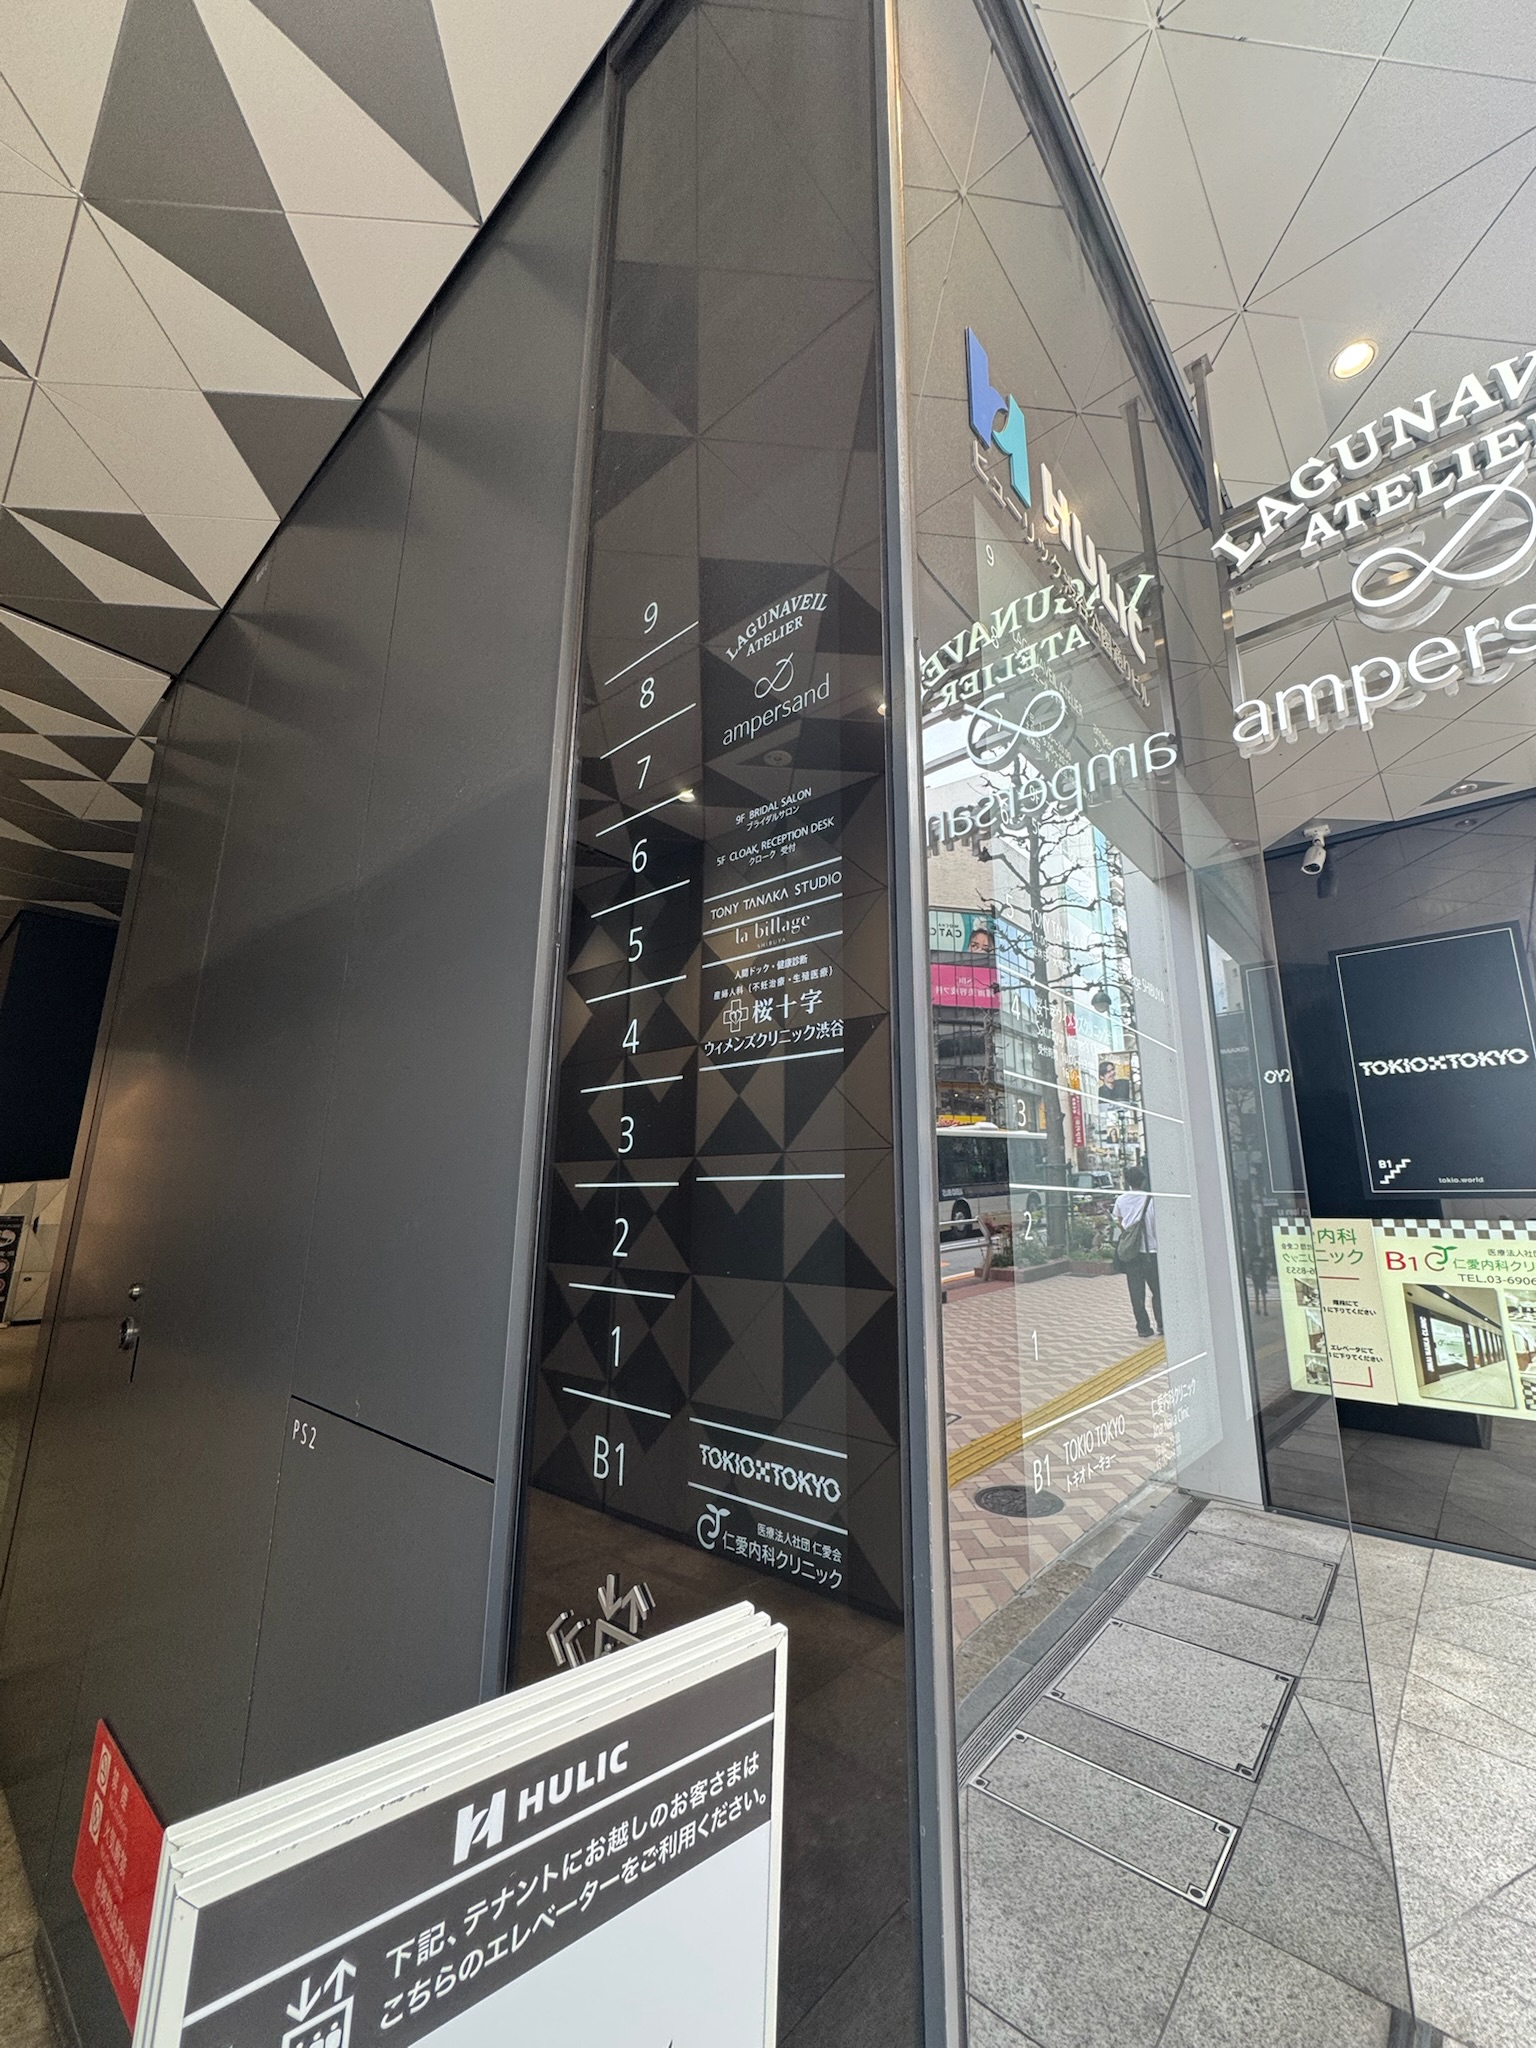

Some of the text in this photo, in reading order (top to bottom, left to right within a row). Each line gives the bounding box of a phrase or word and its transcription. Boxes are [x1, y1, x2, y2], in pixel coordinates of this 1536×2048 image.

[1211, 350, 1536, 573] LAGUNAV
[985, 544, 995, 566] 9
[1040, 462, 1148, 665] HULIC
[643, 601, 658, 634] 9
[725, 592, 829, 662] LAGUNAVEIL
[745, 615, 804, 657] ATELIER
[639, 676, 655, 709] 8
[1232, 603, 1536, 746] ampers
[722, 672, 831, 746] ampersand
[637, 755, 651, 789] 7
[735, 787, 812, 825] 9F BRIDAL SALON
[746, 805, 800, 831] ブライダルサロン
[632, 838, 648, 874] 6
[716, 854, 726, 867] 5F
[761, 825, 809, 850] RECEPTION
[811, 816, 835, 834] DESK
[748, 849, 776, 866] クローク
[710, 871, 843, 920] TONY TANAKA STUDIO
[628, 926, 643, 963] 5
[734, 914, 811, 944] la billage
[734, 954, 808, 980] 人間ドック・健康診断
[752, 988, 823, 1024] 桜十字
[1011, 994, 1021, 1021] 4
[622, 1018, 639, 1054] 4
[704, 1018, 844, 1057] ウィメンズクリニック渋谷
[1017, 1099, 1027, 1127] 3
[618, 1116, 634, 1153] 3
[1378, 1159, 1393, 1169] B1
[1438, 1176, 1485, 1184] tokio.world
[612, 1217, 629, 1258] 2
[1023, 1211, 1034, 1241] 2
[1312, 1228, 1357, 1245] 内科
[1385, 1250, 1418, 1272] B1
[1453, 1258, 1535, 1273] 仁愛内科クリ
[611, 1326, 622, 1367] 1
[1031, 1330, 1039, 1361] 1
[292, 1418, 318, 1450] PS2
[1062, 1414, 1126, 1466] TOKIO TOKYO
[593, 1434, 625, 1487] B1
[1033, 1453, 1051, 1495] B1
[722, 1530, 843, 1590] 仁愛内科クリニック
[757, 1522, 843, 1564] 医療法人社団 仁愛会
[517, 1740, 631, 1823] HULIC
[385, 1750, 761, 1980] 下記、テナントにお越しのお客さまは
[380, 1792, 768, 2032] こちらのエレベーターをご利用ください。
